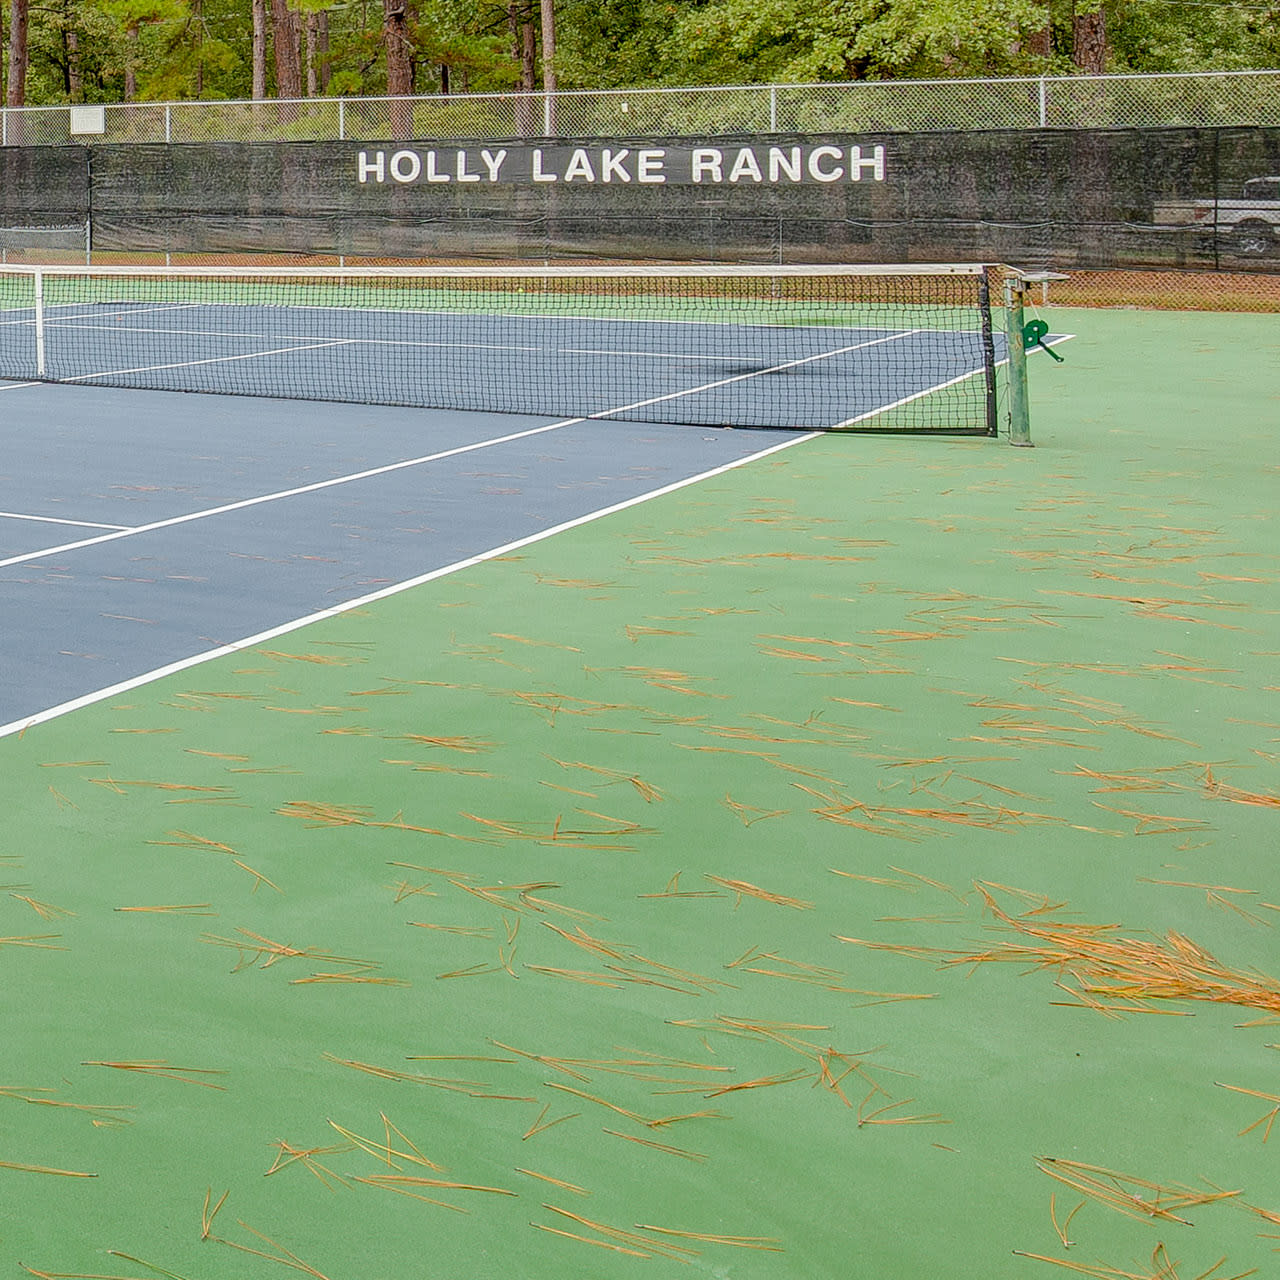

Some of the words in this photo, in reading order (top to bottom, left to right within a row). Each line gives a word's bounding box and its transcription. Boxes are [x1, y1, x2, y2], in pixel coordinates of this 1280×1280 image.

[358, 149, 507, 183] HOLLY
[532, 148, 666, 183] LAKE
[691, 145, 886, 183] RANCH
